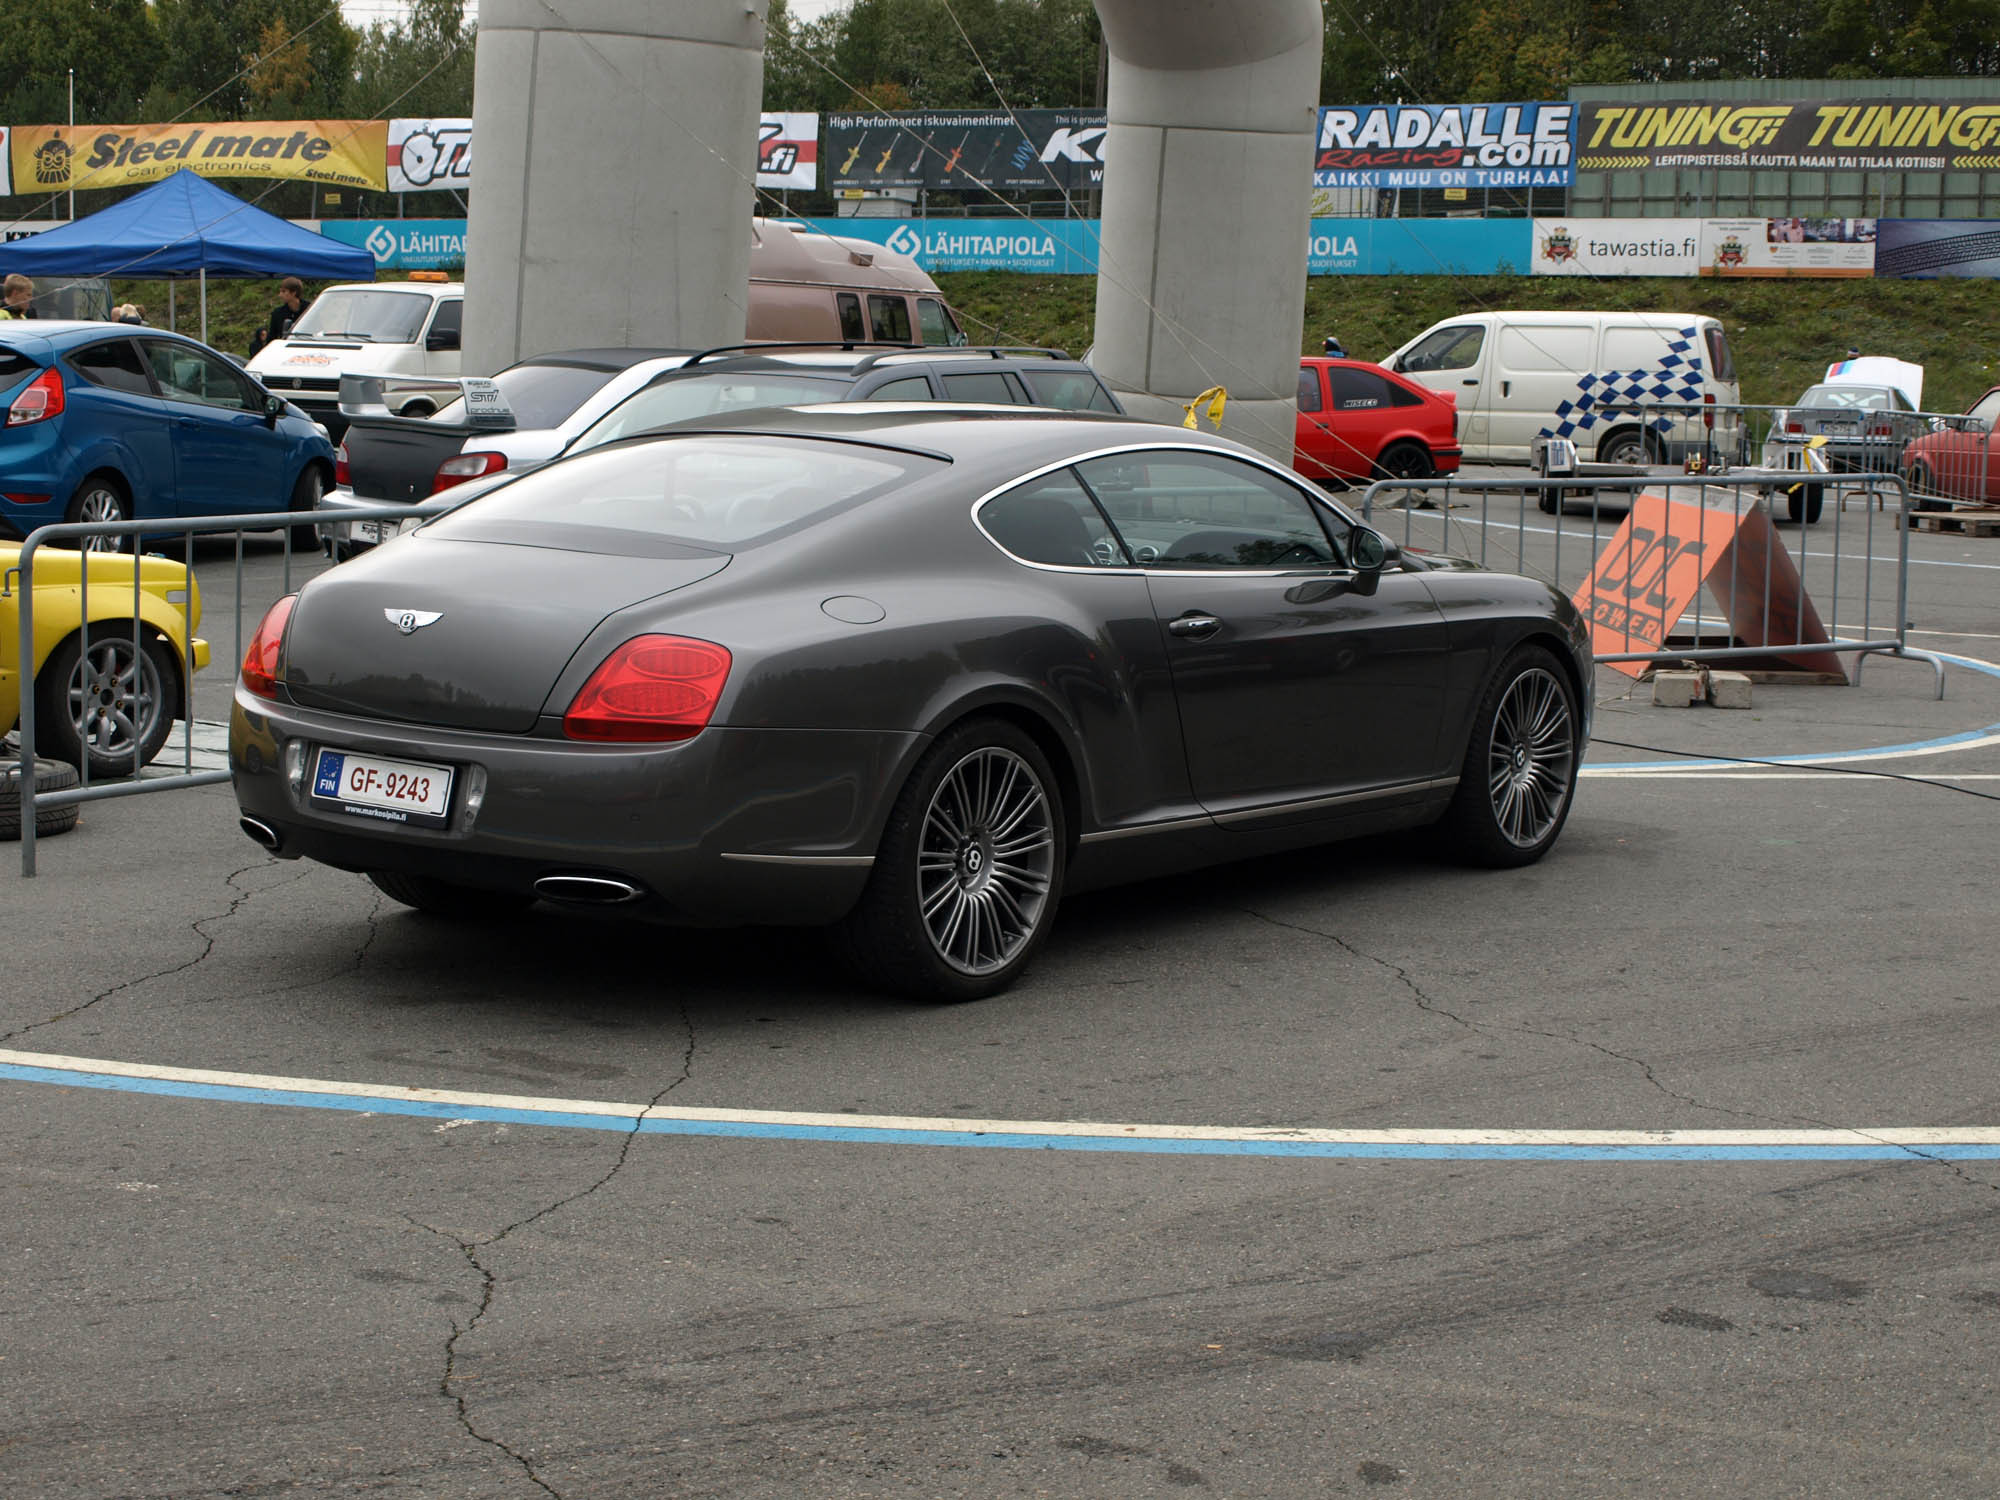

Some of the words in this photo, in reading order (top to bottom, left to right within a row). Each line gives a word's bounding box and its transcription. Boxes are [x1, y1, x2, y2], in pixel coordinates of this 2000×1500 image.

[829, 116, 854, 129] High
[855, 114, 923, 128] Performance
[924, 114, 1016, 127] iskuvaimentimet
[1318, 105, 1572, 149] RADALLE
[86, 129, 205, 169] Steel
[201, 131, 332, 161] mate
[1316, 147, 1463, 169] Racing
[1462, 141, 1572, 168] .com
[126, 167, 157, 178] Car
[164, 161, 272, 174] electronics
[1654, 153, 1748, 167] LEHTIPISTEISSÄ
[1750, 155, 1797, 166] KAUTTA
[1800, 156, 1836, 167] MAAN
[1838, 157, 1857, 167] TAI
[1859, 157, 1893, 168] TILAA
[305, 168, 336, 180] Steel
[336, 174, 368, 185] mate
[1313, 171, 1380, 186] KAIKKI
[1389, 170, 1432, 185] MUU
[1440, 170, 1467, 185] ON
[1476, 169, 1569, 185] TURHAA!
[925, 231, 1056, 256] LÄHITAPIOLA
[1590, 238, 1696, 257] tawastia.fi
[319, 778, 336, 792] FIN
[350, 767, 430, 803] GF-9243
